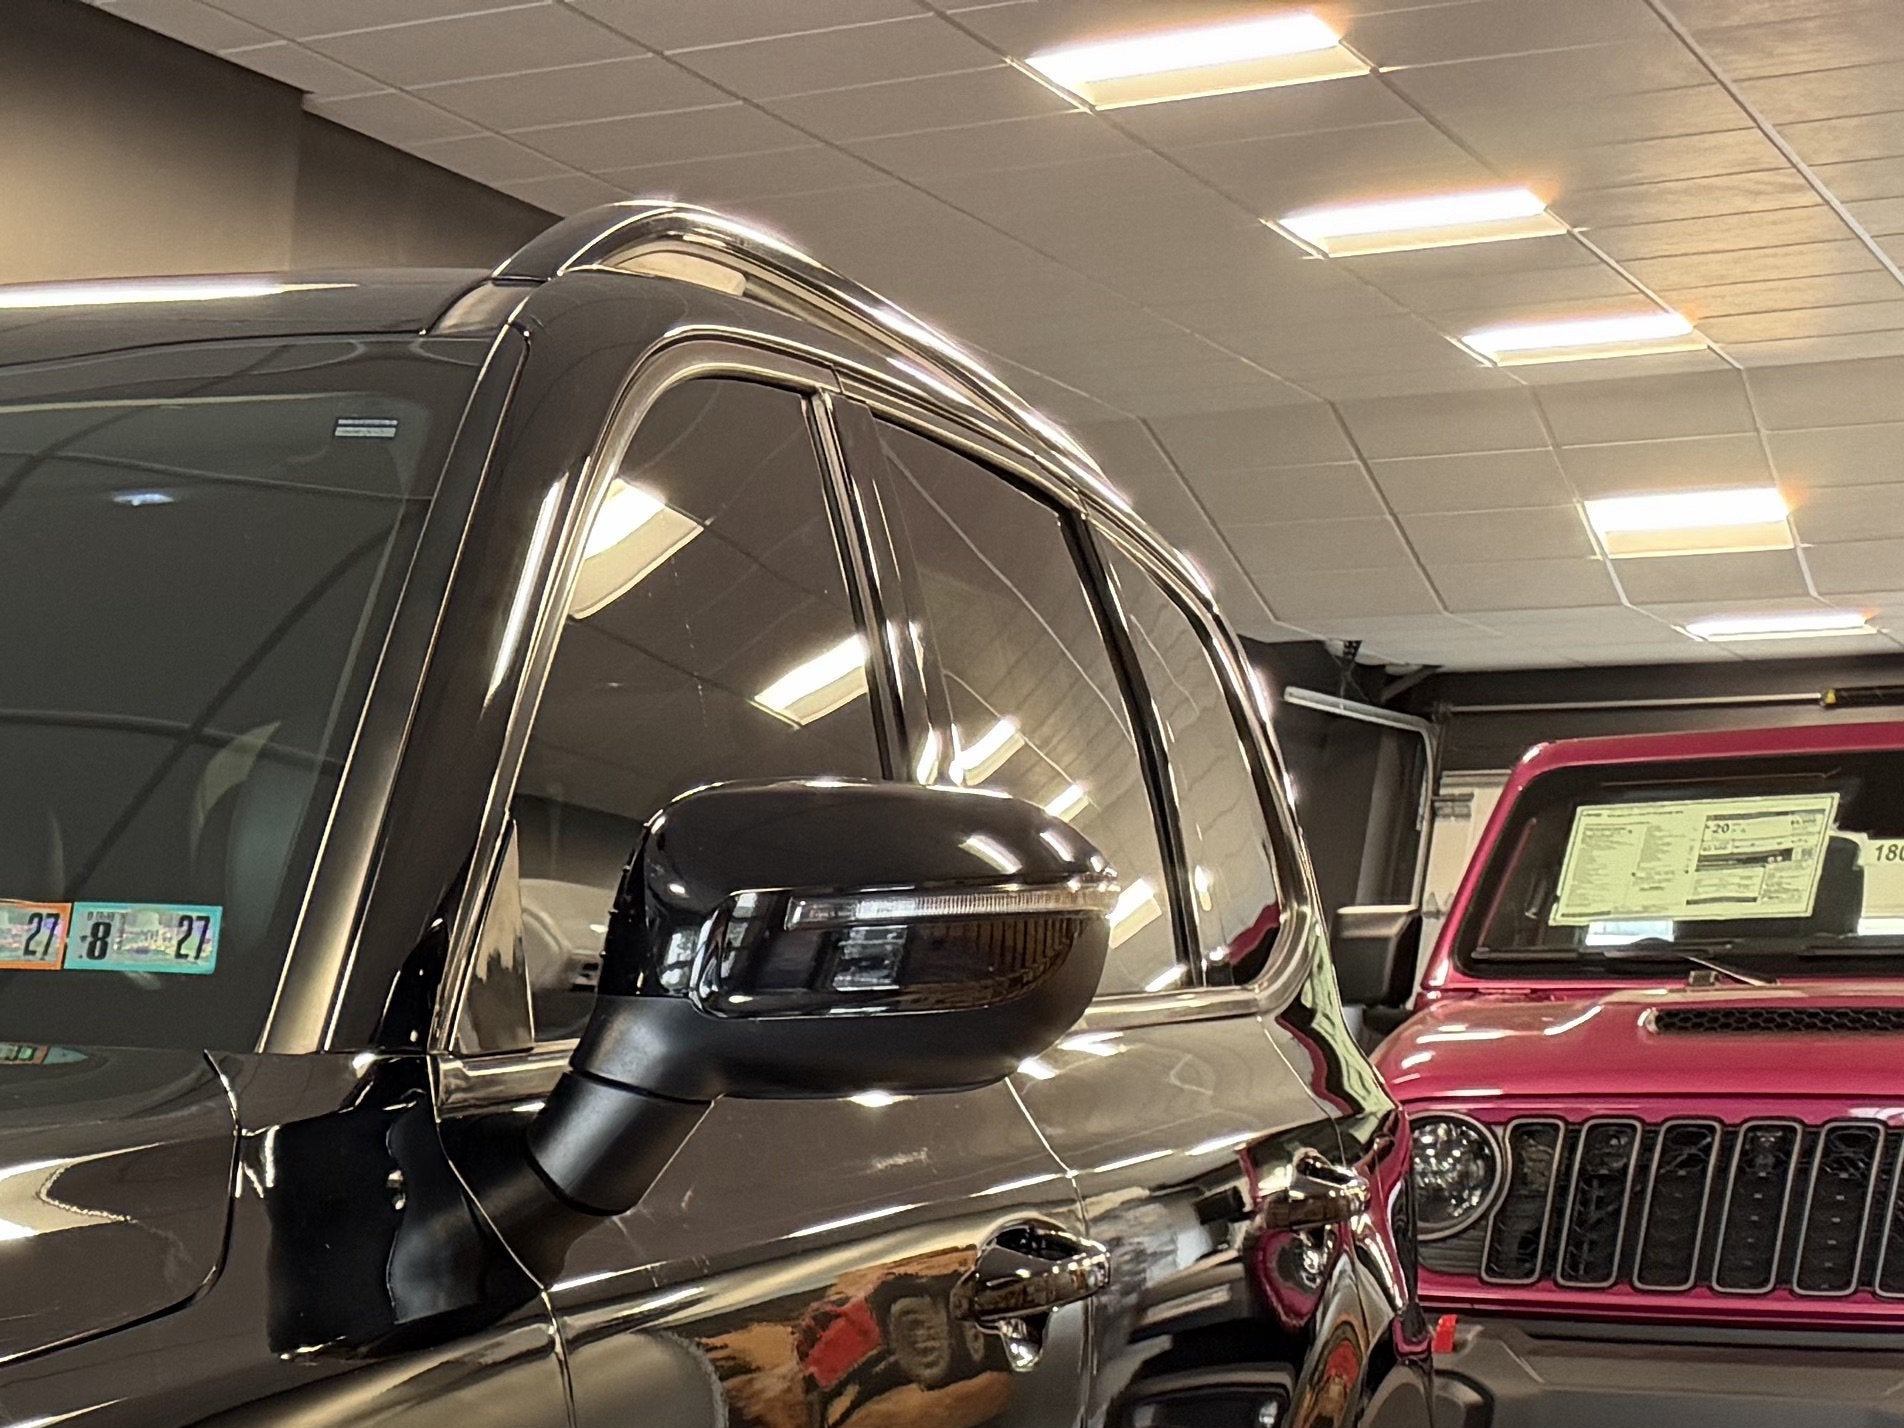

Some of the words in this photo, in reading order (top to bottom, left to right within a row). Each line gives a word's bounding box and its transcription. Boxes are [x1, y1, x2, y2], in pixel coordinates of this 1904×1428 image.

[23, 912, 60, 956] 27
[86, 921, 112, 960] 8
[175, 915, 210, 960] 27
